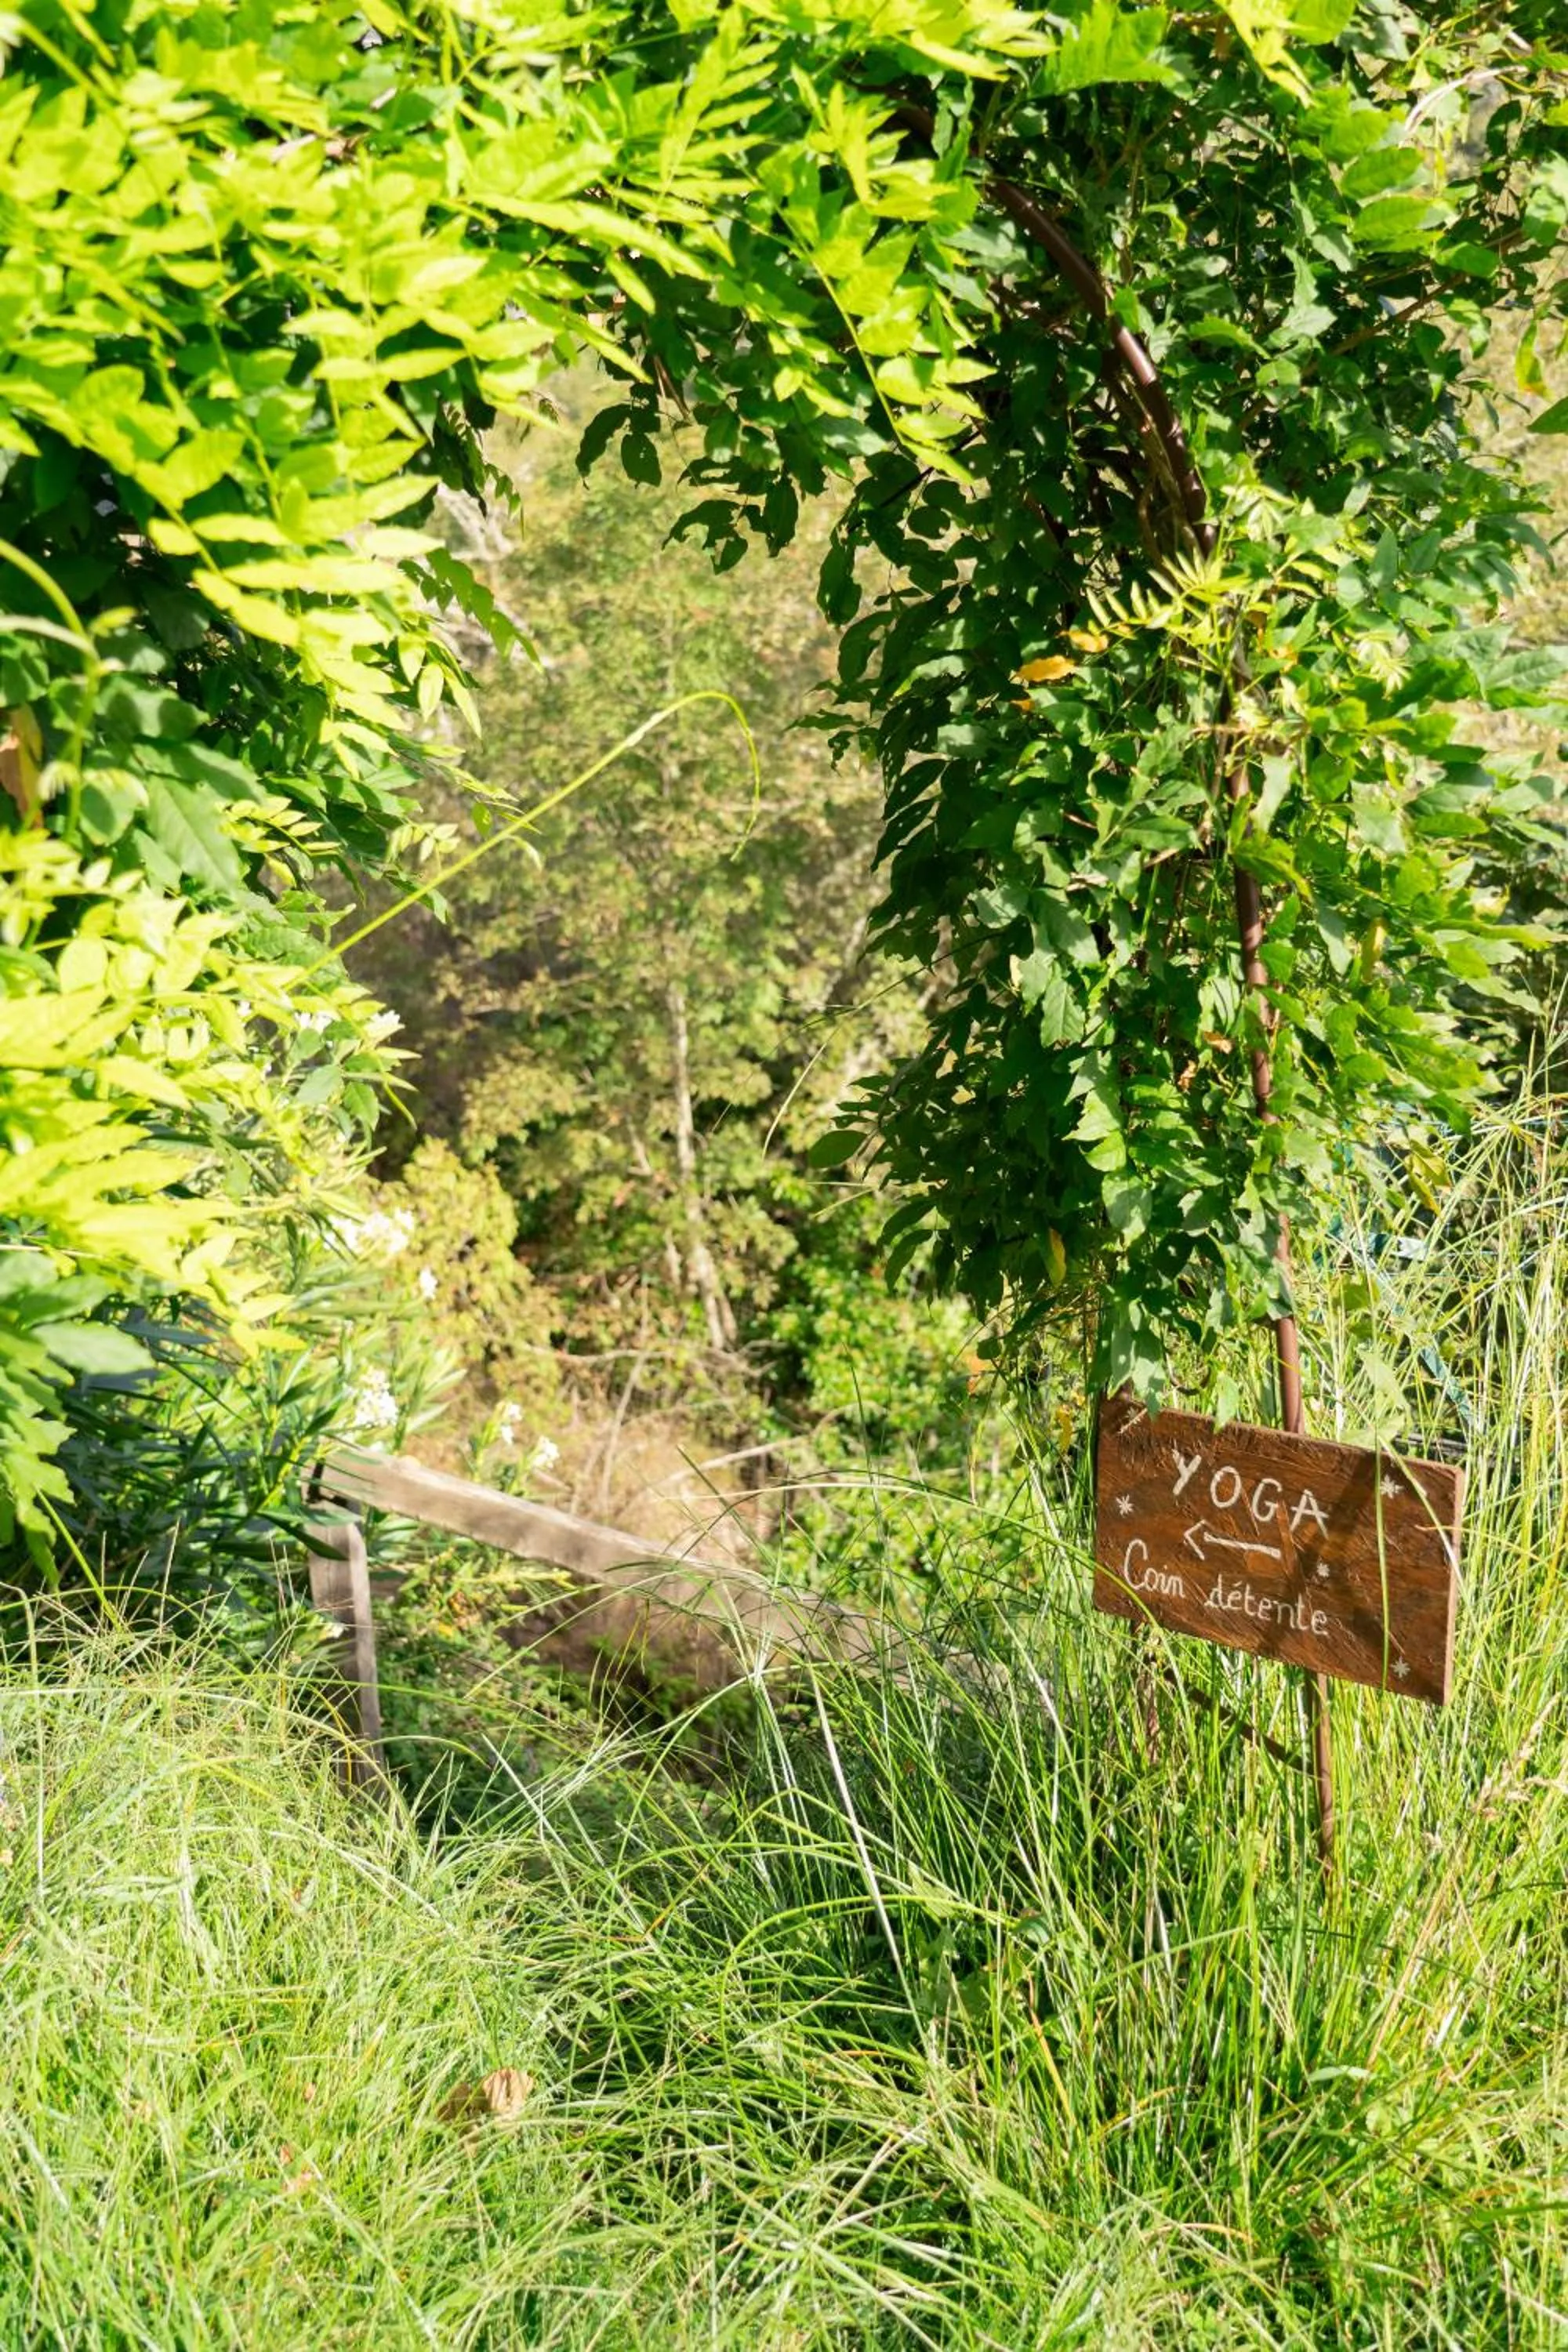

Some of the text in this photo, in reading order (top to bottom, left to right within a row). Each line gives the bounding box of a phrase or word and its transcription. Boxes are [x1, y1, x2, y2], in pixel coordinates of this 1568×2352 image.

[1172, 1449, 1329, 1539] YOGA
[1123, 1538, 1330, 1636] Coin détente
